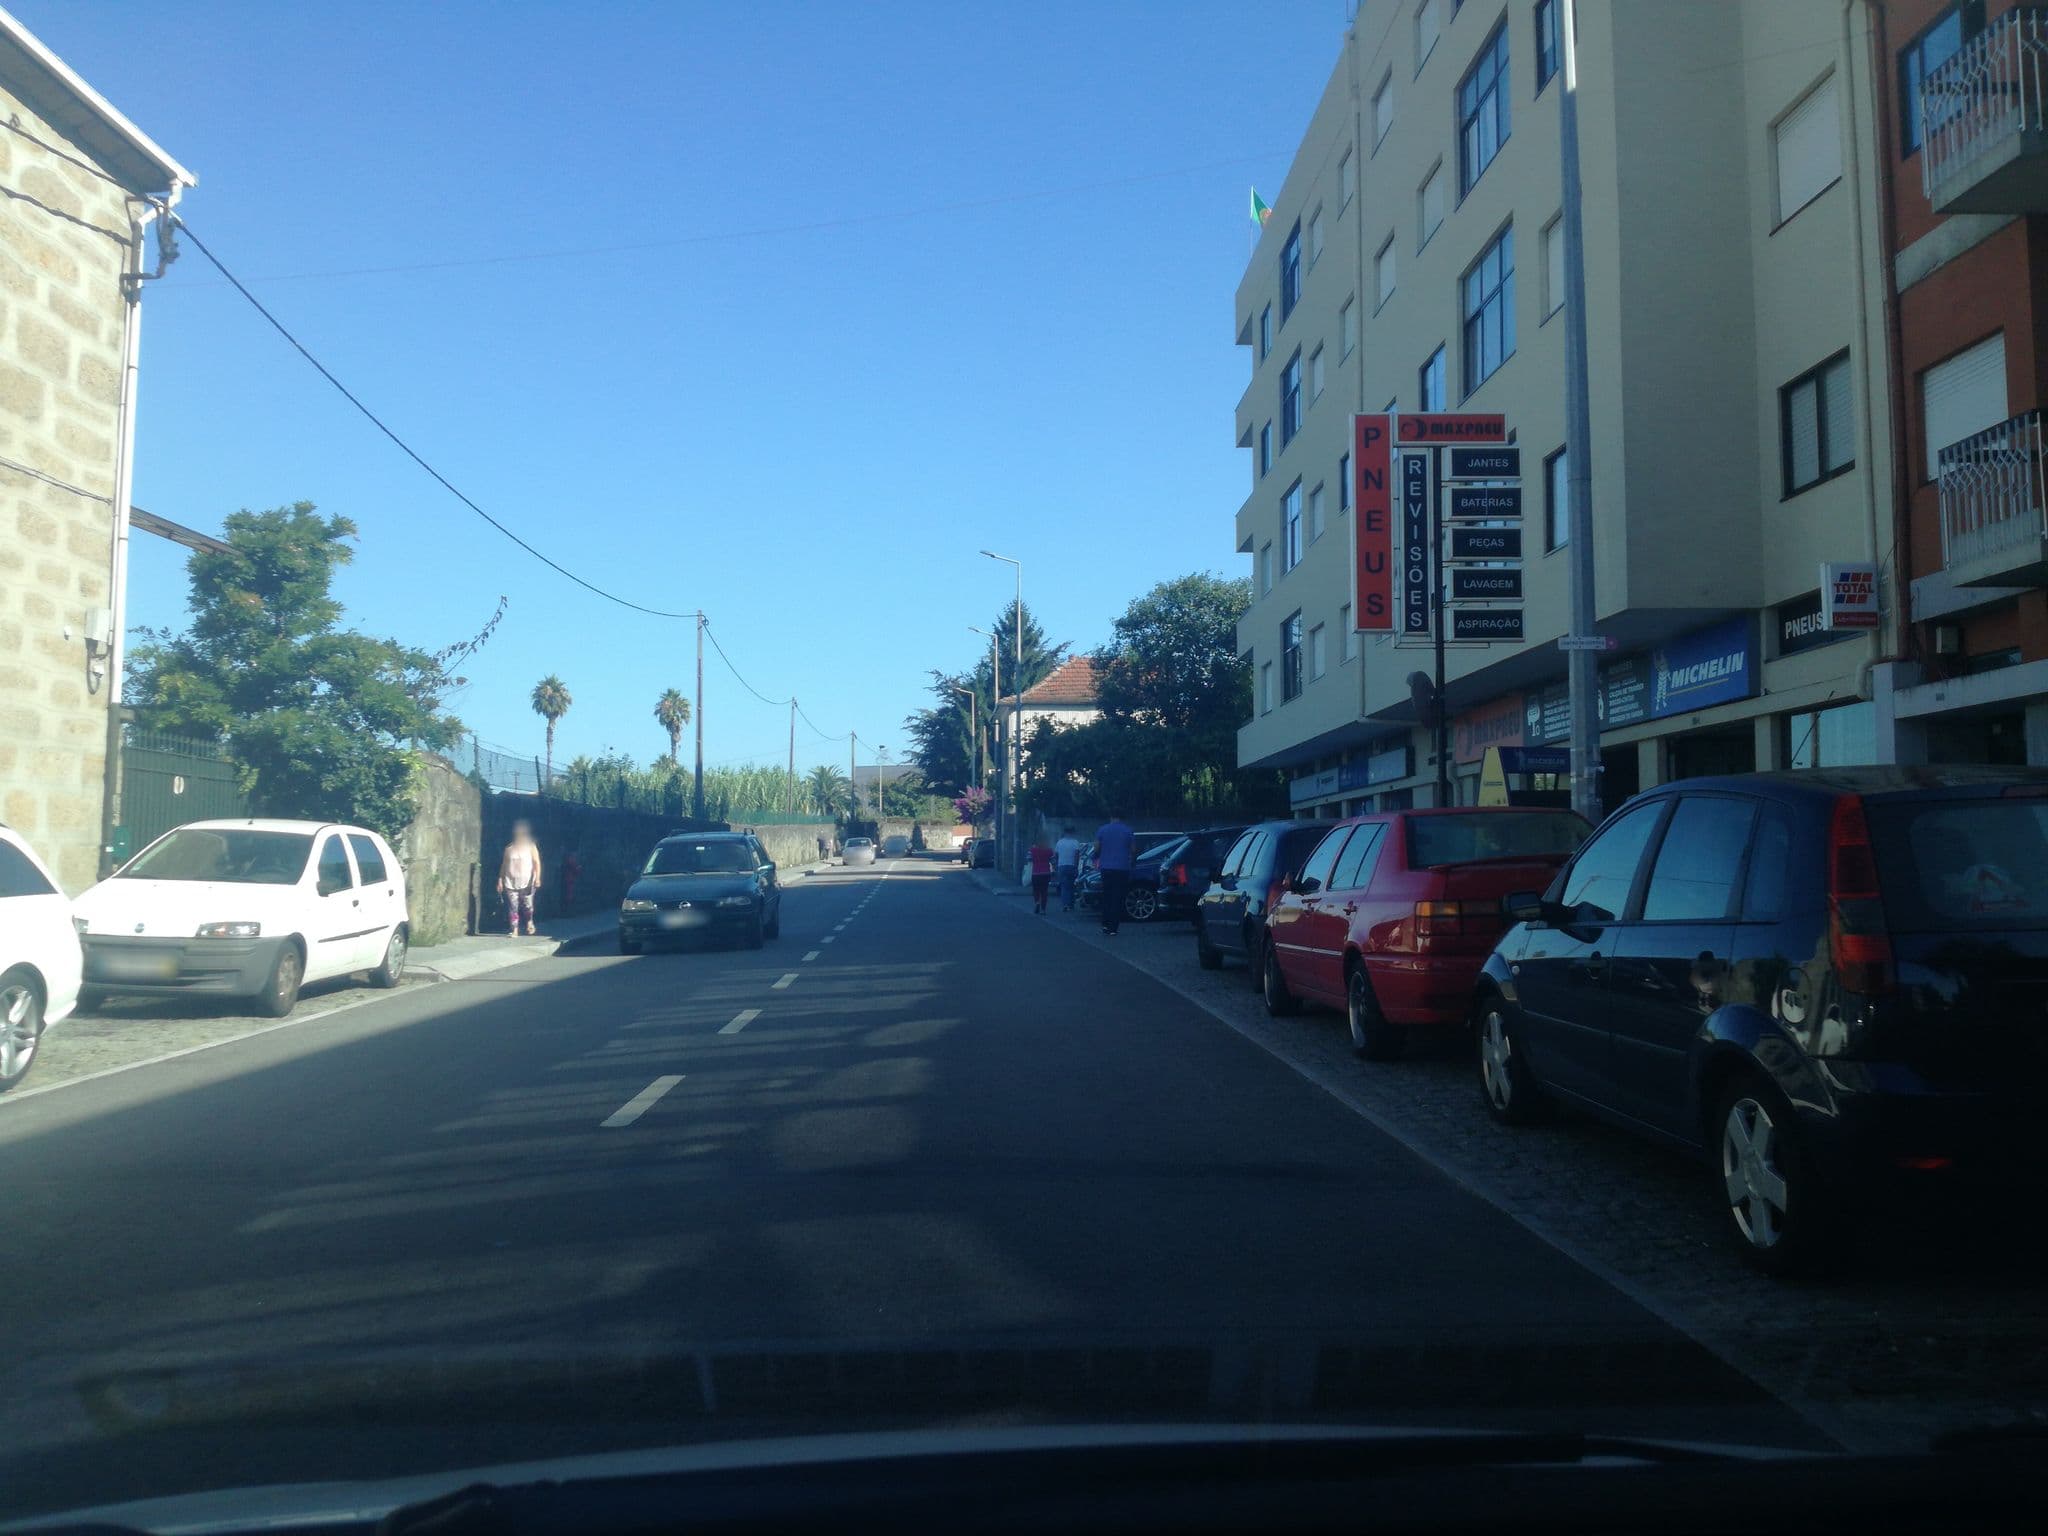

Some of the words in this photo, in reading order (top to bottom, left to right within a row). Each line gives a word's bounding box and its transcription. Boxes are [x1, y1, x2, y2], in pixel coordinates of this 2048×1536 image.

[1467, 458, 1509, 468] JANTES
[1460, 498, 1514, 508] BATERIAS
[1364, 427, 1385, 616] PNEUS
[1409, 459, 1424, 628] REVISÕES
[1469, 538, 1505, 549] PEÇAS
[1463, 579, 1514, 589] LAVAGEM
[1833, 583, 1874, 594] TOTAL
[1457, 615, 1520, 629] ASPIRAÇÃO
[1785, 611, 1824, 640] PNEUS
[1671, 651, 1745, 689] MICHELIN
